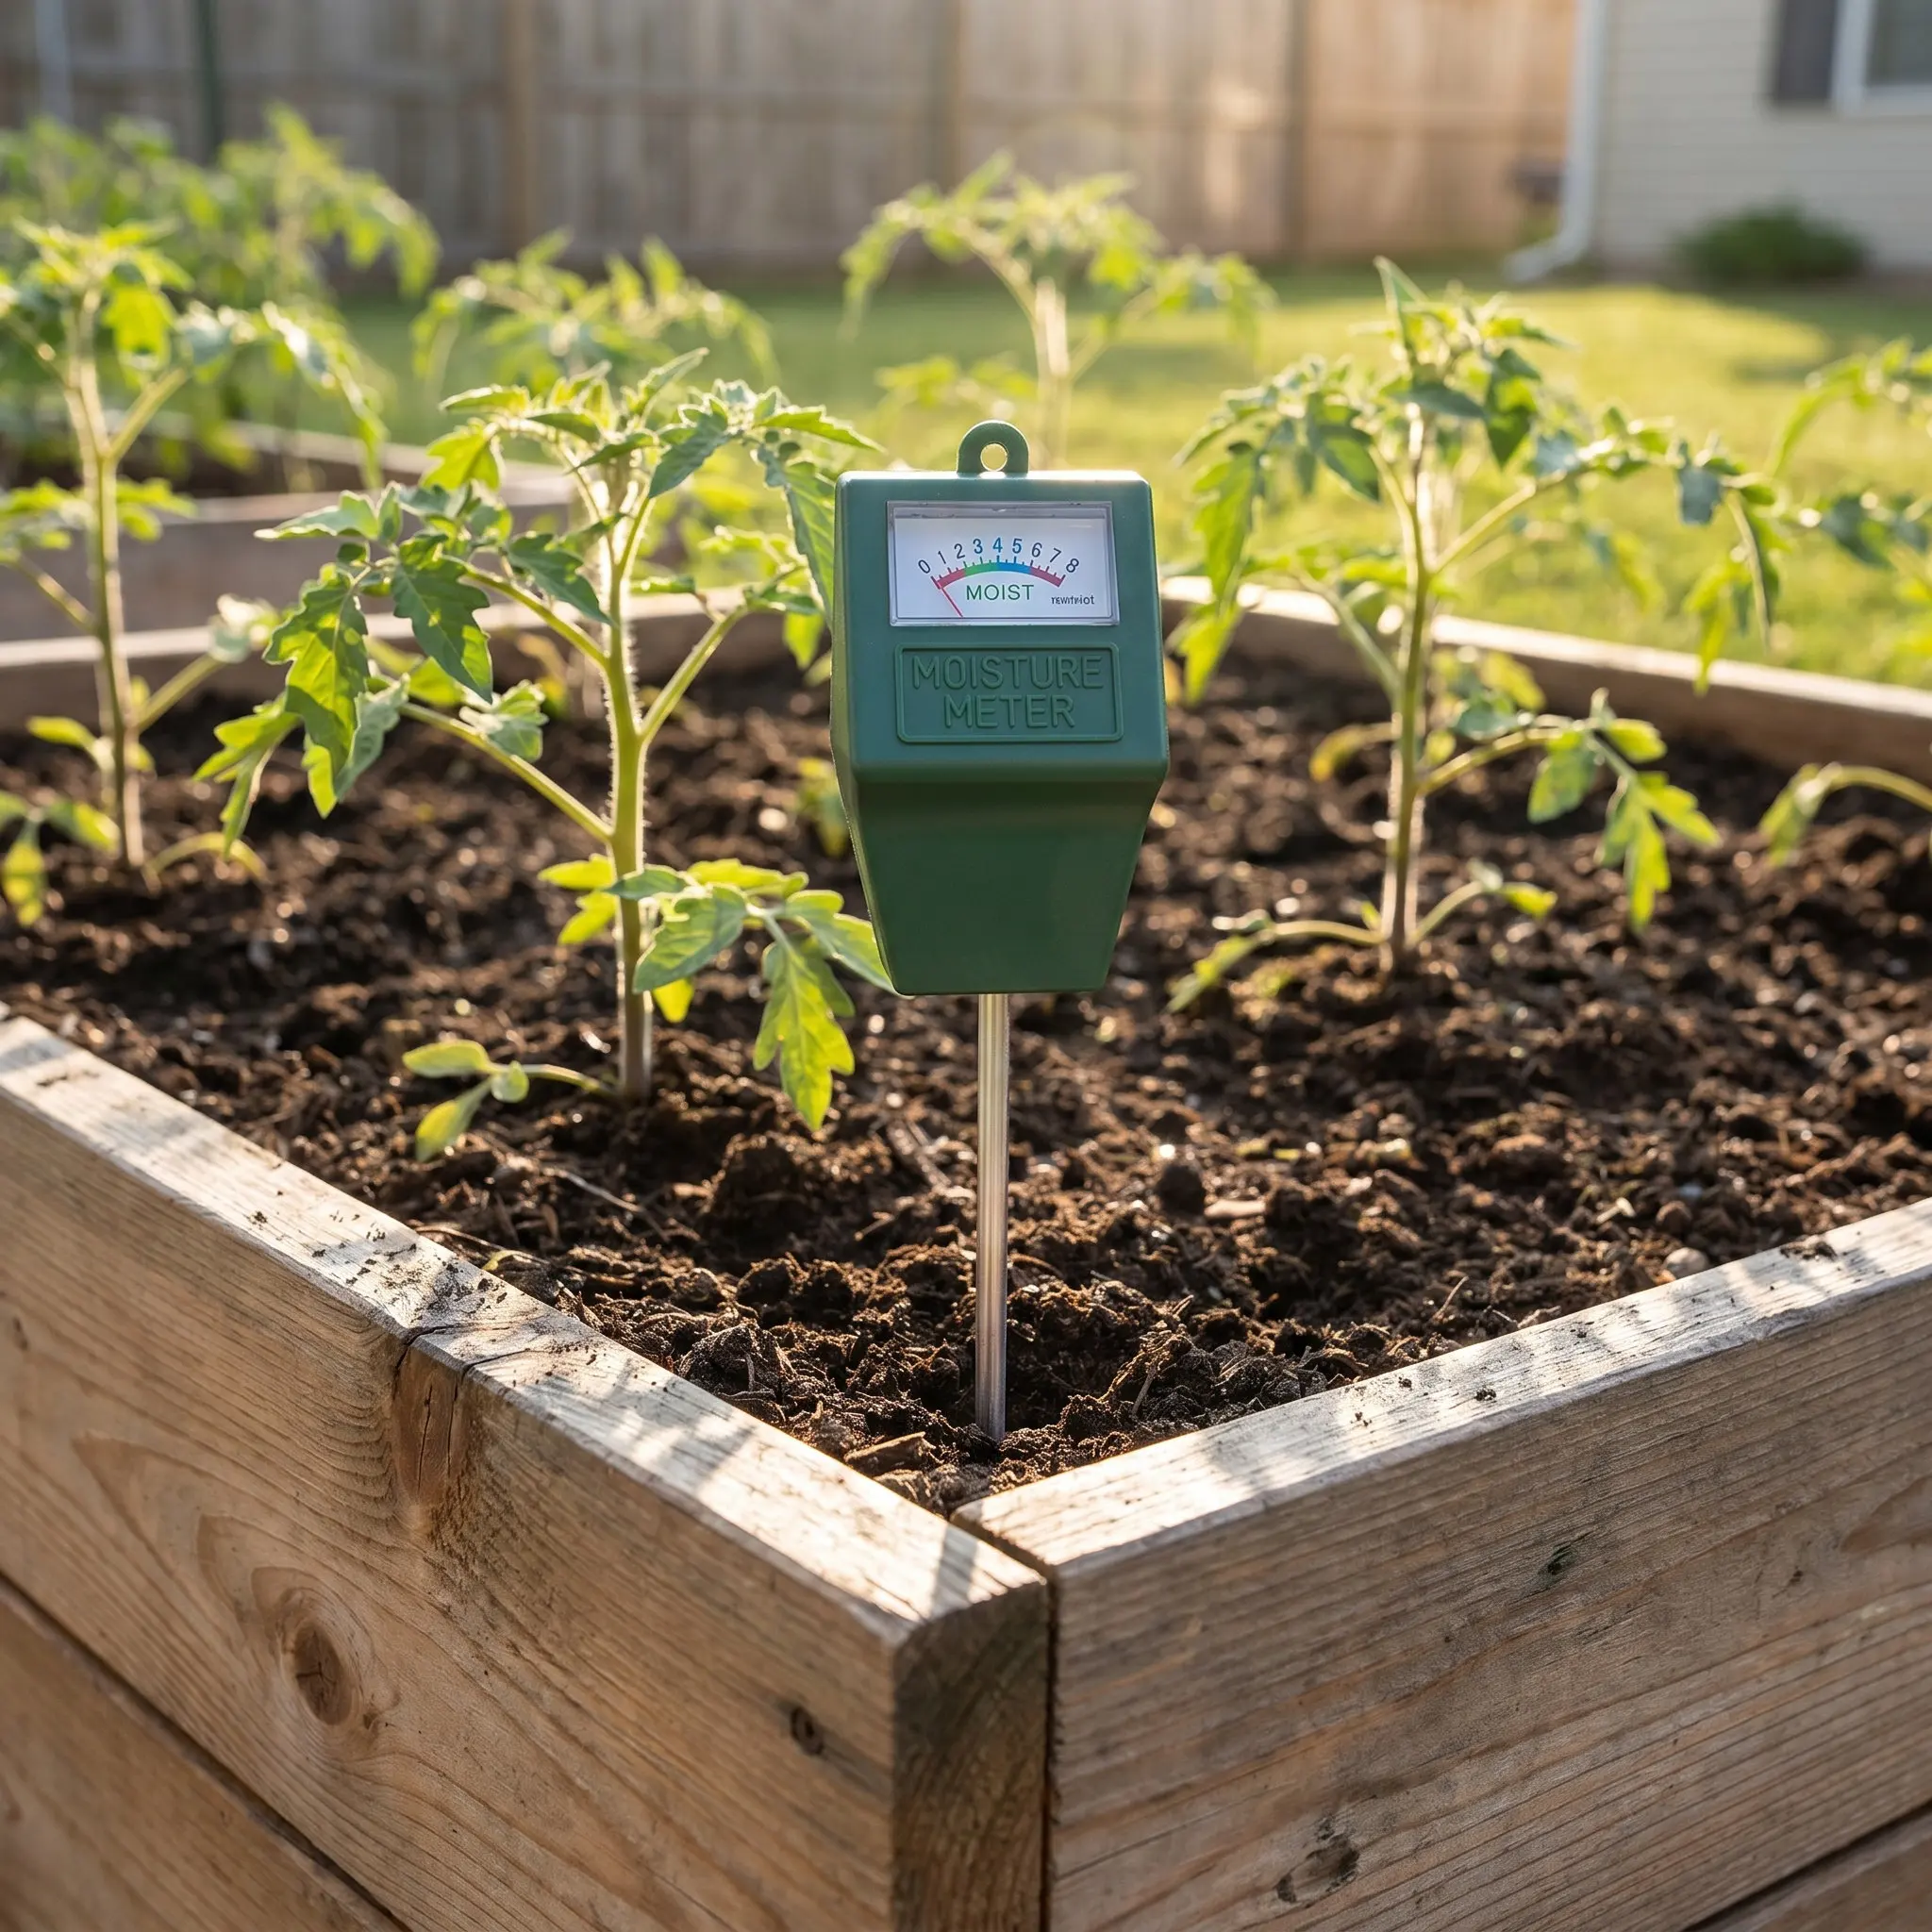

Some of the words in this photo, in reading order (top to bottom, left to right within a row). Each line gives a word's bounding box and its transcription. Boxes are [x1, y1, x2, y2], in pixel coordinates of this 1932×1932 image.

[918, 559, 931, 574] 0
[938, 550, 946, 565] 1
[954, 543, 965, 559] 2
[973, 538, 983, 555] 3
[992, 537, 1003, 553] 4
[1012, 538, 1023, 554] 5
[1031, 542, 1042, 558] 6
[1049, 547, 1061, 563] 7
[1066, 558, 1079, 574] 8
[966, 584, 1034, 601] MOIST
[911, 655, 1105, 690] MOISTURE
[943, 694, 1076, 729] METER
